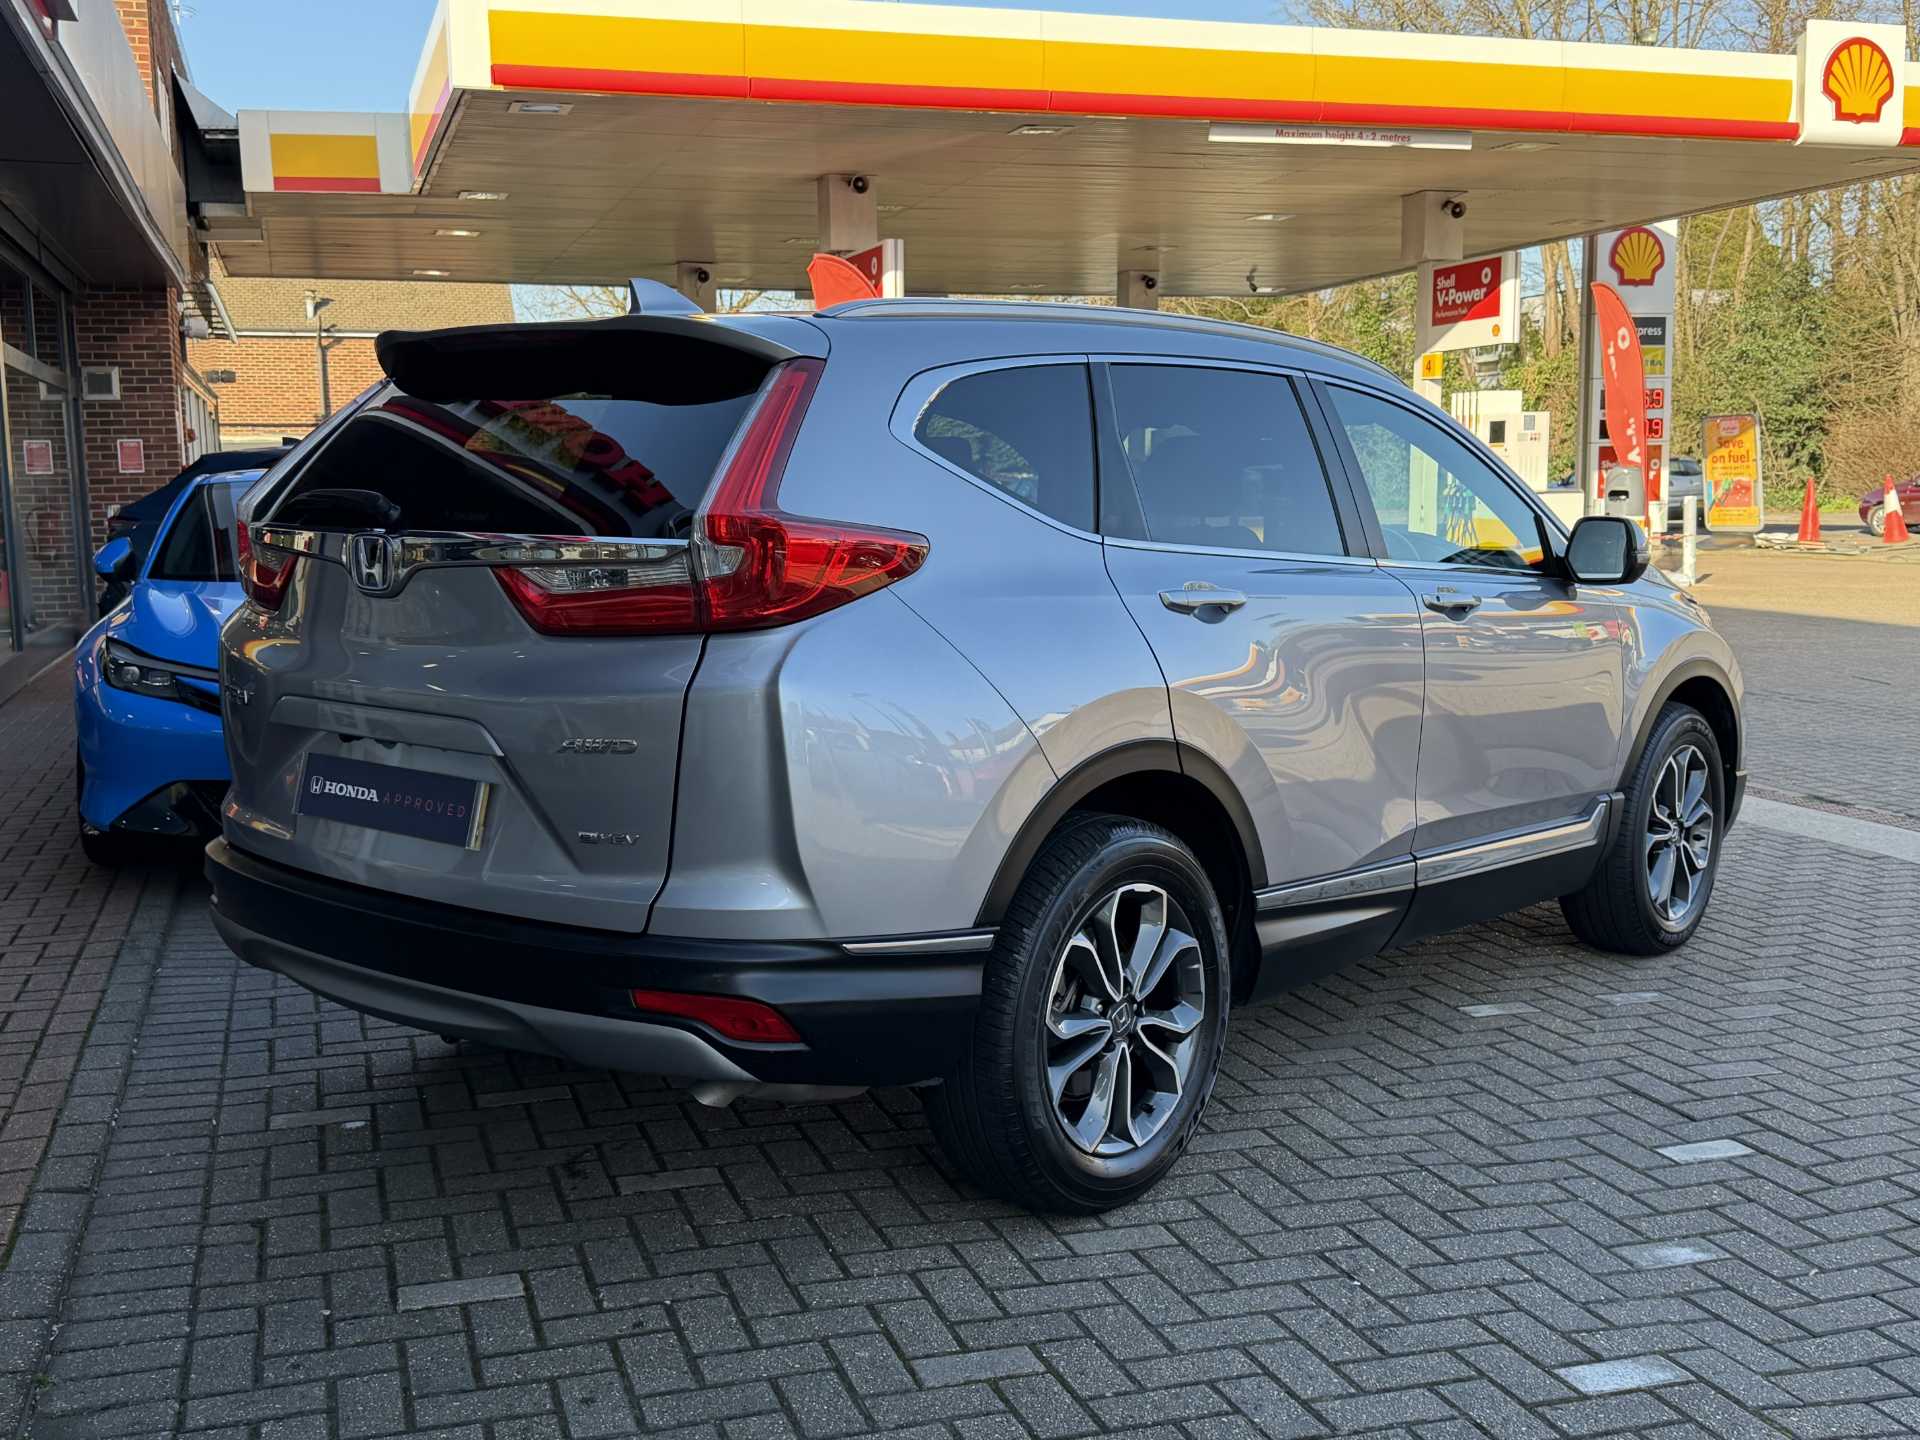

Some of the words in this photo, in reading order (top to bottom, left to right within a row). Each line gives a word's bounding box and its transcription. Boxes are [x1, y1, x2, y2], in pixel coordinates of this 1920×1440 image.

[1274, 128, 1323, 139] Maximum
[1325, 128, 1354, 142] height
[1380, 133, 1411, 143] metres
[1436, 273, 1456, 290] Shell
[1436, 287, 1487, 307] V-Power
[1637, 327, 1662, 337] press
[1425, 359, 1432, 373] 4
[1716, 436, 1744, 449] Save
[1711, 455, 1726, 464] on
[1728, 449, 1750, 464] fuel
[559, 737, 639, 754] AWD
[323, 780, 379, 803] HONDA
[383, 791, 466, 818] APPROVED
